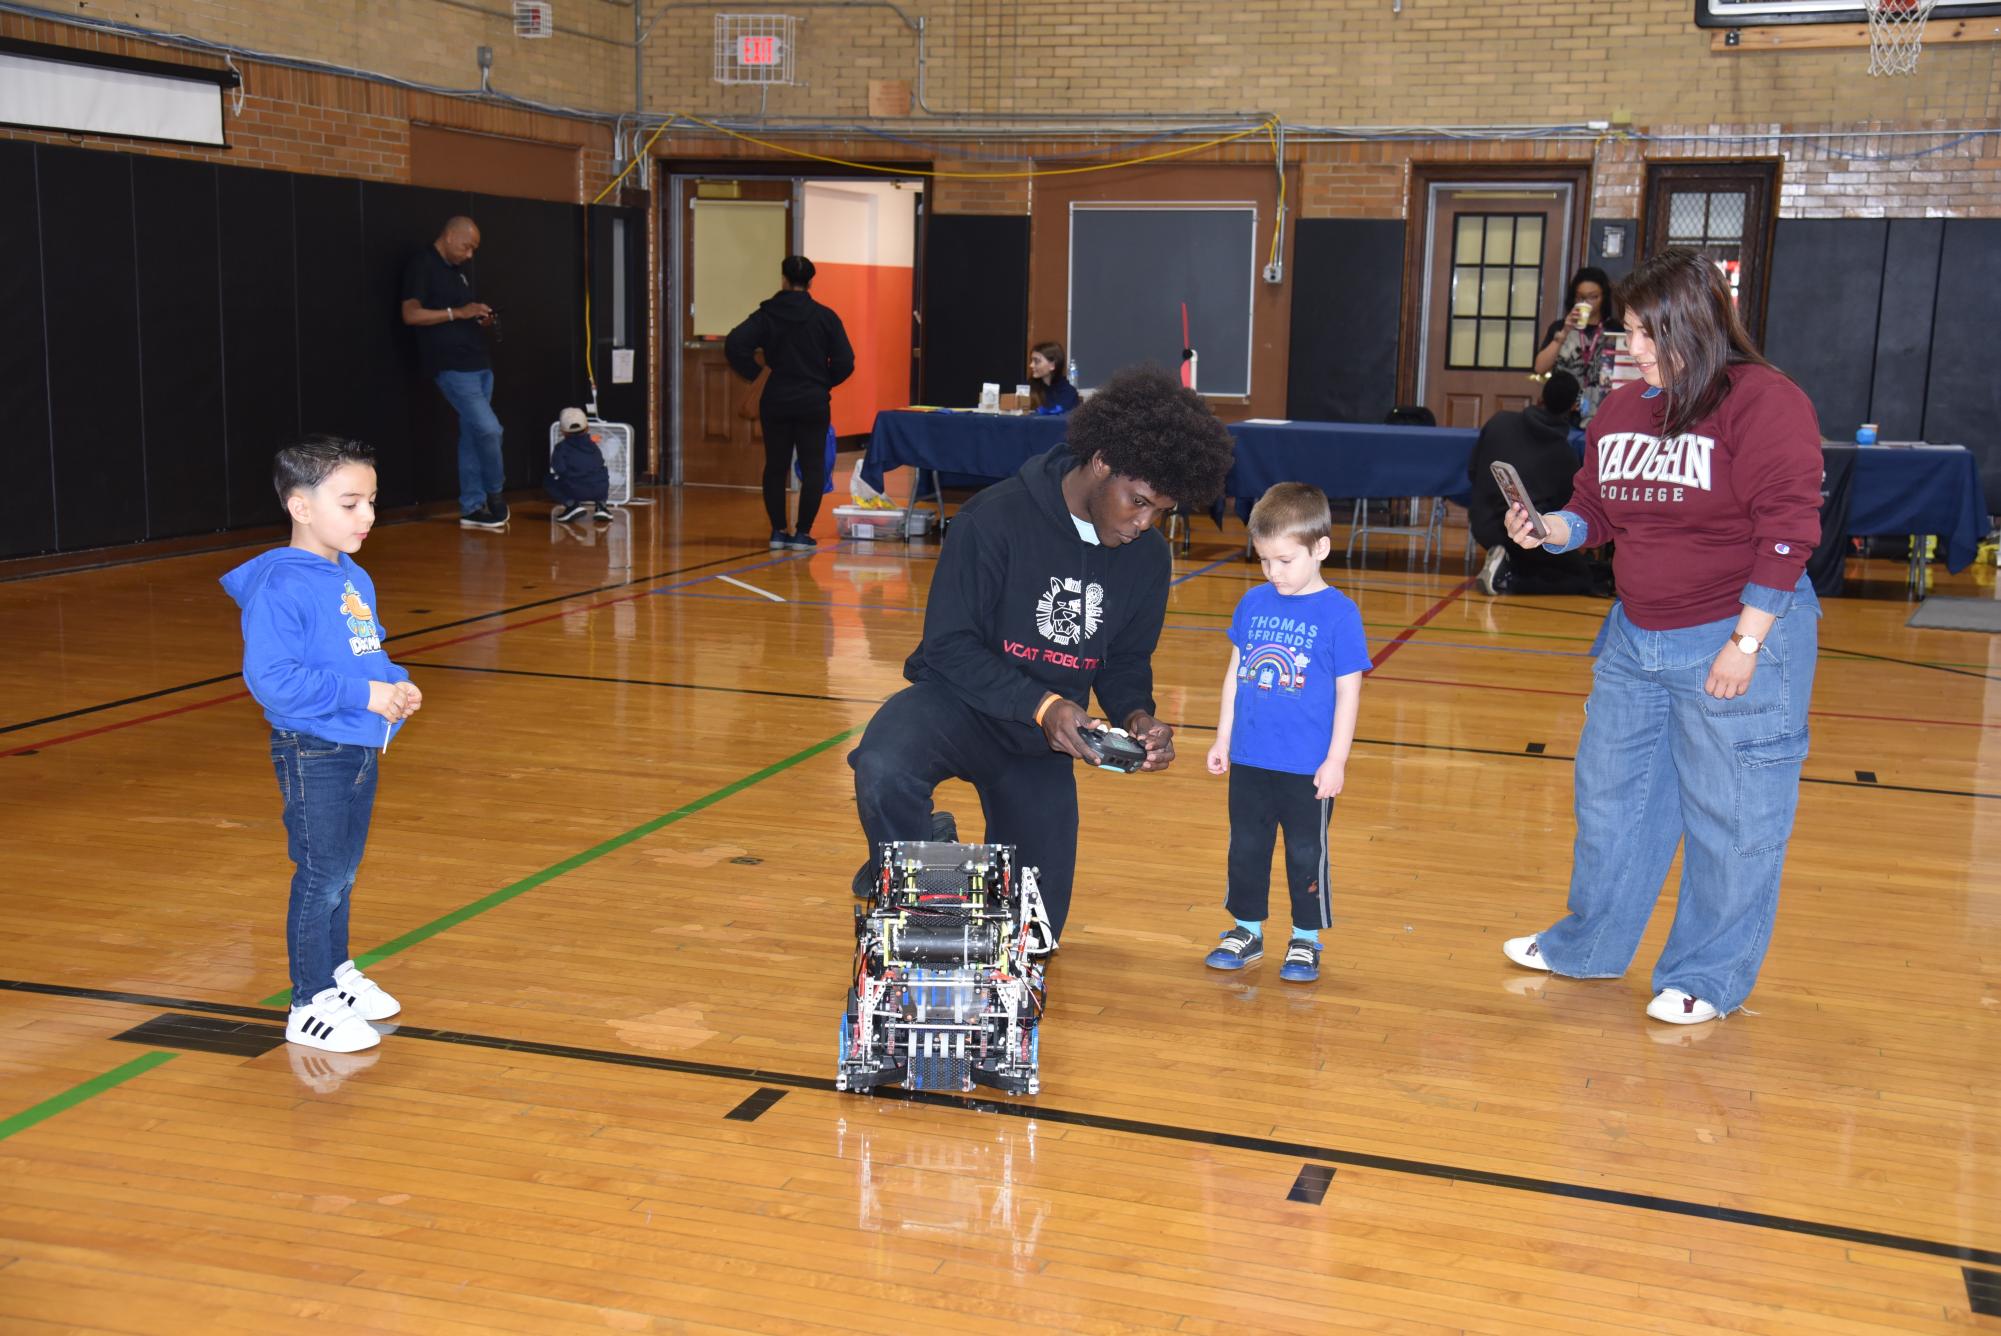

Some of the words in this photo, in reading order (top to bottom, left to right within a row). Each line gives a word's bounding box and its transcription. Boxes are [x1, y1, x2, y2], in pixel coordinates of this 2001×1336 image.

[744, 37, 773, 64] EXIT
[1598, 432, 1715, 491] VAUGHN
[1600, 485, 1684, 502] COLLEGE
[1251, 616, 1318, 637] THOMAS
[1004, 640, 1039, 661] VCAT
[1043, 650, 1099, 670] ROBOTI
